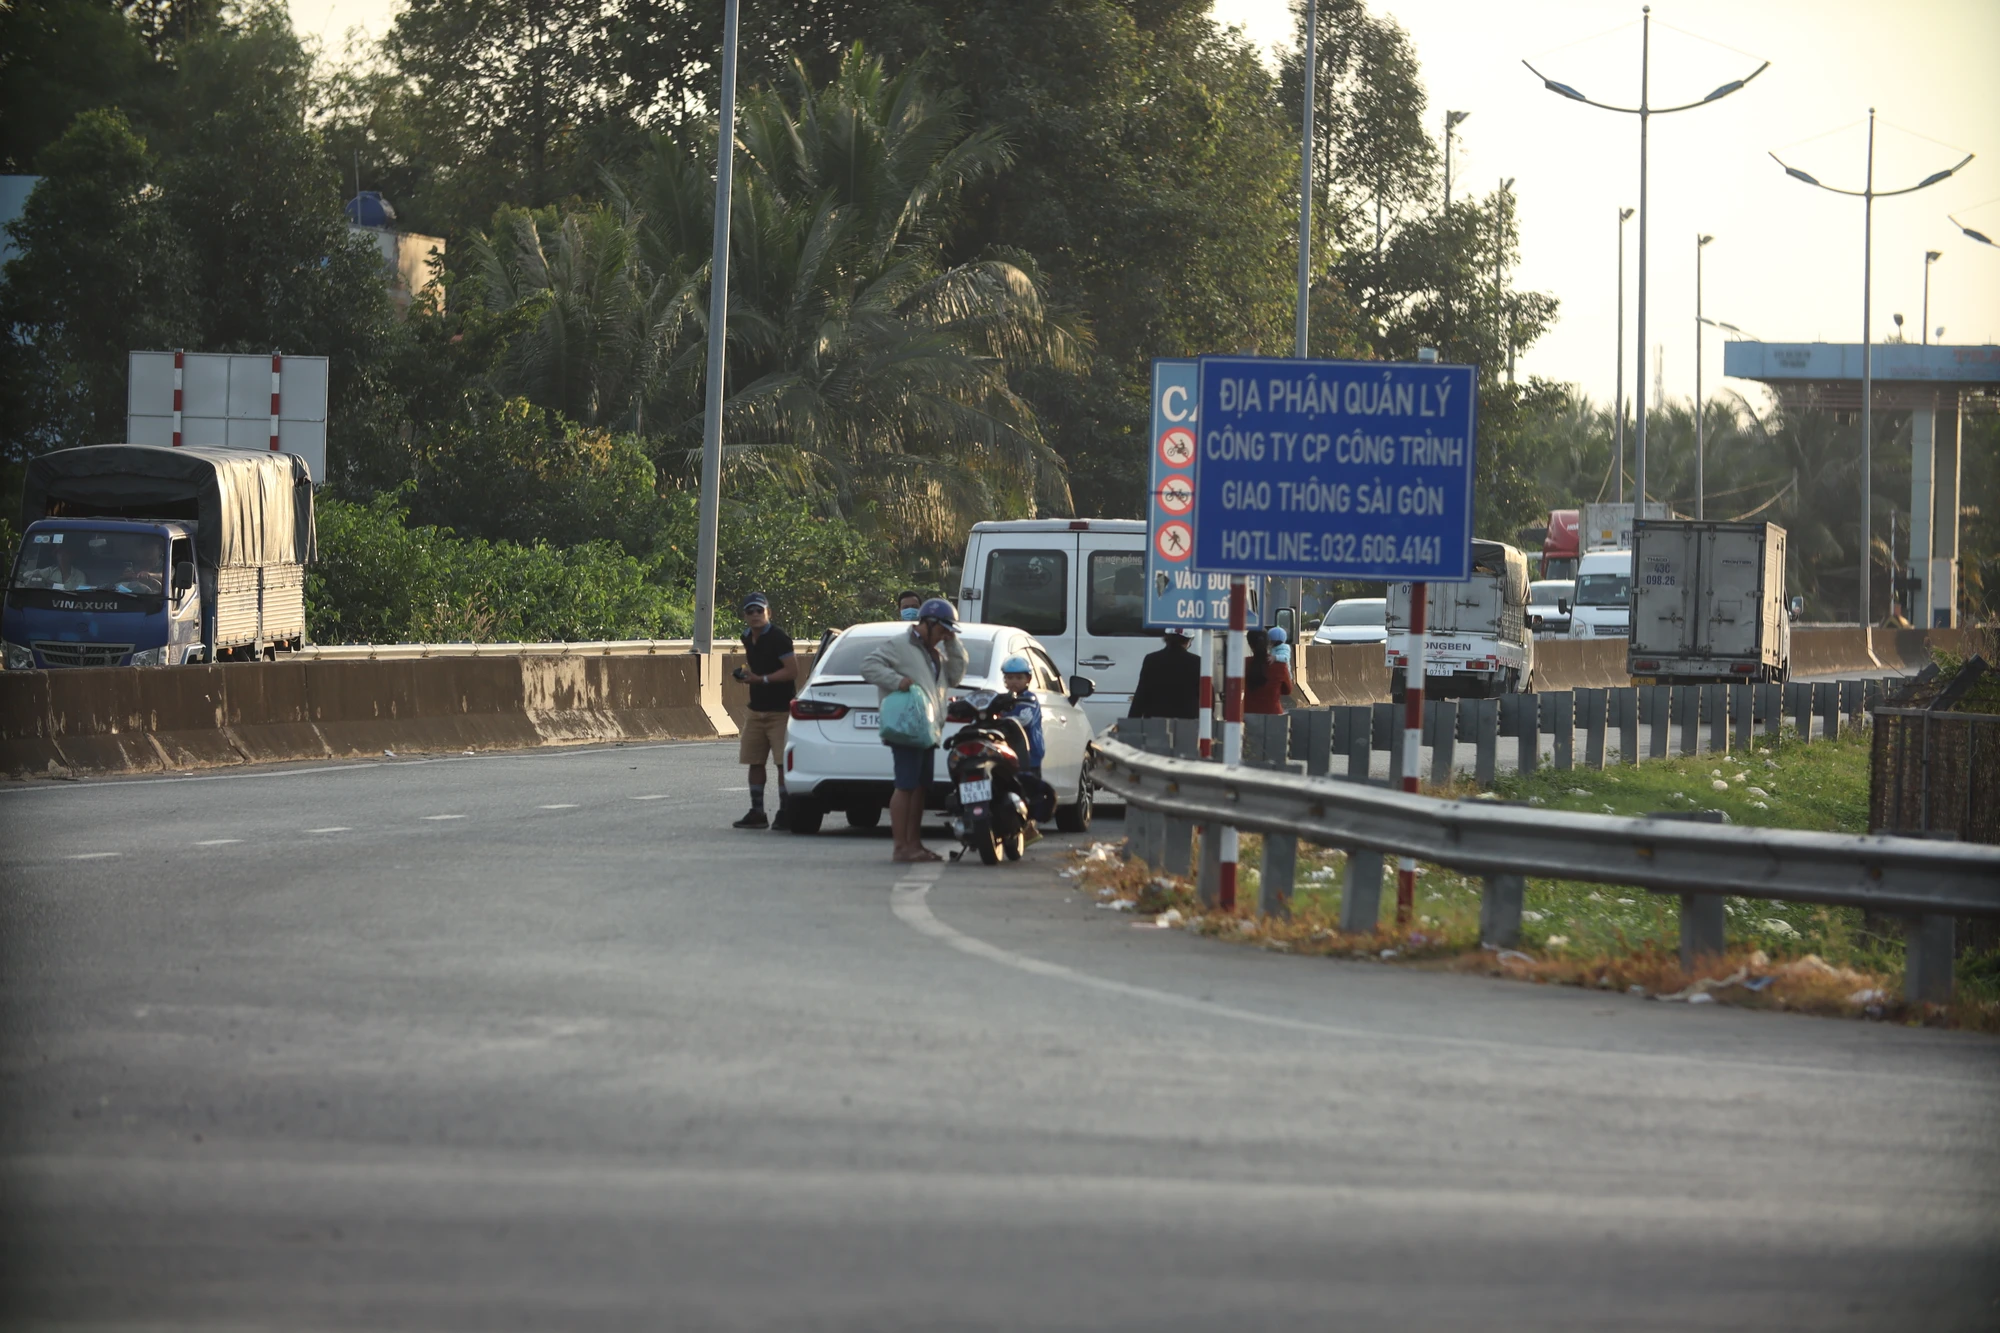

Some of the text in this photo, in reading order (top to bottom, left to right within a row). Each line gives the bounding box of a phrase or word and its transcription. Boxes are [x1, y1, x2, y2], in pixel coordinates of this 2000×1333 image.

[1219, 370, 1452, 420] ĐỊA PHẬN QUẢN LÝ
[1206, 423, 1463, 467] CÔNG TY CP CÔNG TRÌNH
[1222, 475, 1444, 516] GIAO THÔNG SÀI GÒN
[1646, 575, 1675, 586] 098.26
[1654, 564, 1671, 574] 43C
[52, 599, 118, 610] VINAXUKI
[1176, 594, 1230, 620] CAO TỐ
